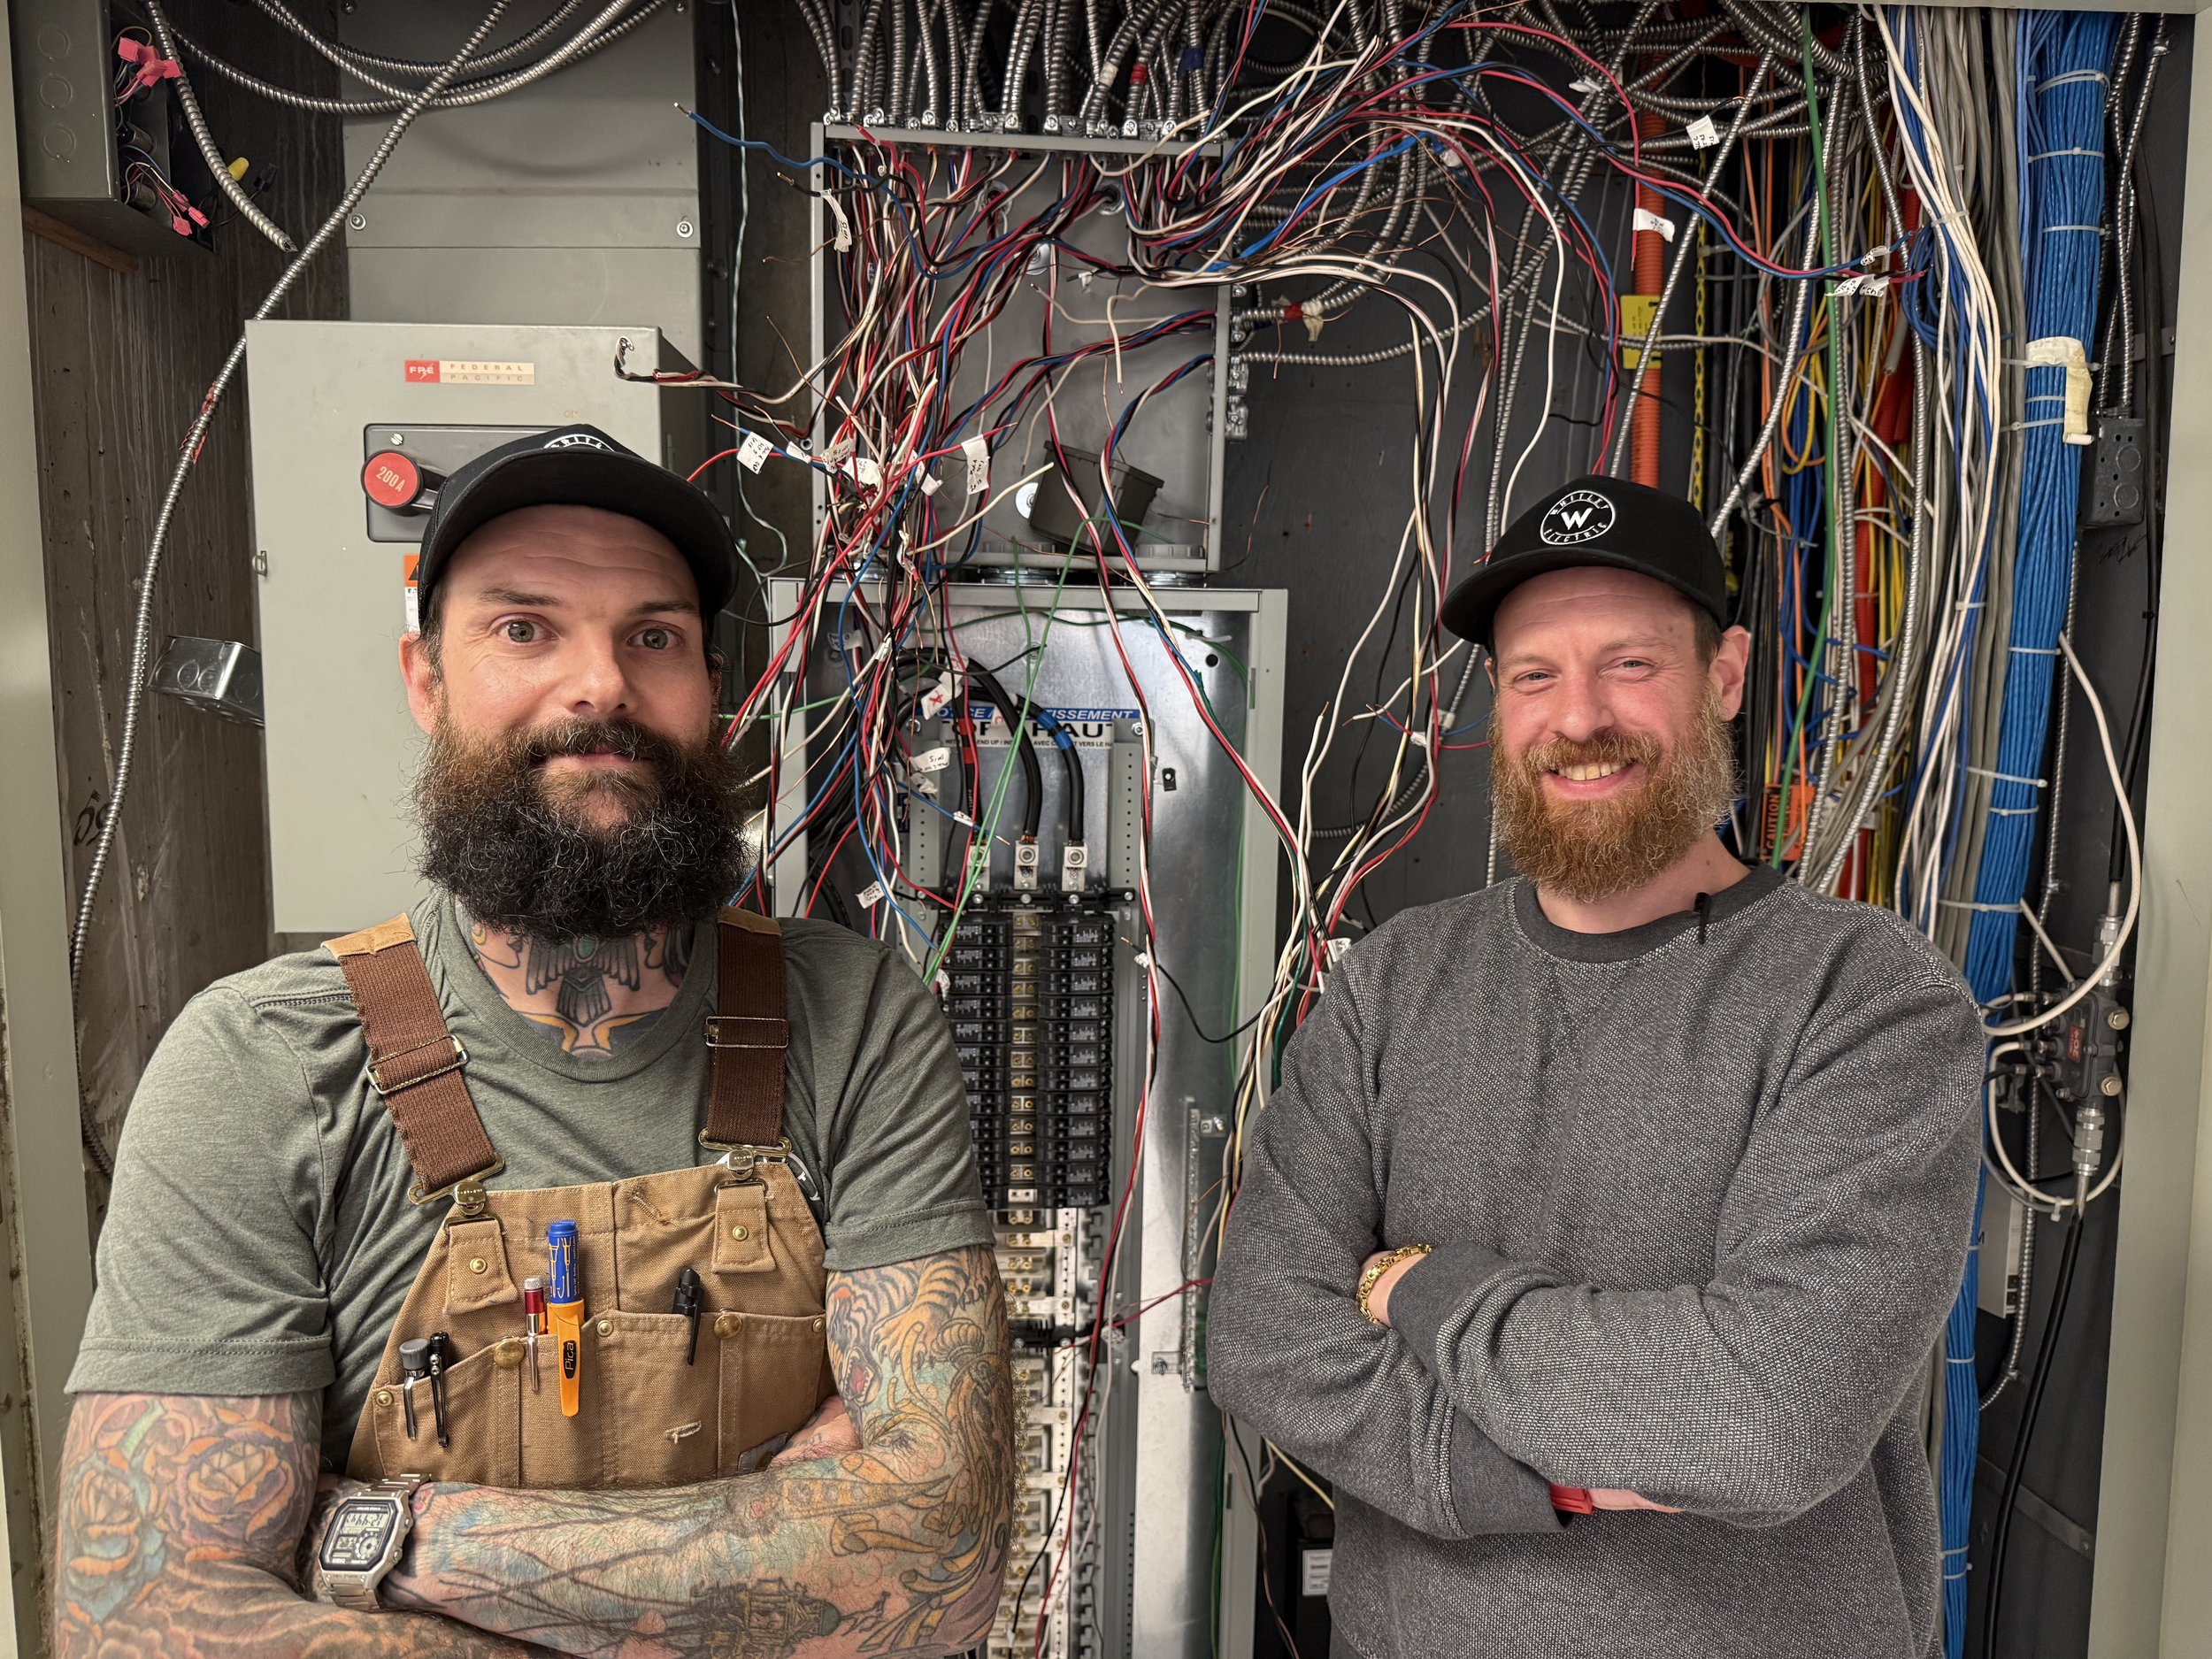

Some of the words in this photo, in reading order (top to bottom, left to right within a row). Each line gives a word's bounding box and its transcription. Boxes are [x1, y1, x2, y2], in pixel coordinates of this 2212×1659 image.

[449, 363, 524, 372] FEDERAL
[375, 465, 406, 492] 200A
[1549, 493, 1609, 515] WHITLEY
[1560, 507, 1594, 531] W
[1543, 522, 1608, 542] ELECTRIC
[1032, 722, 1114, 738] HAU
[565, 1341, 574, 1371] Pica
